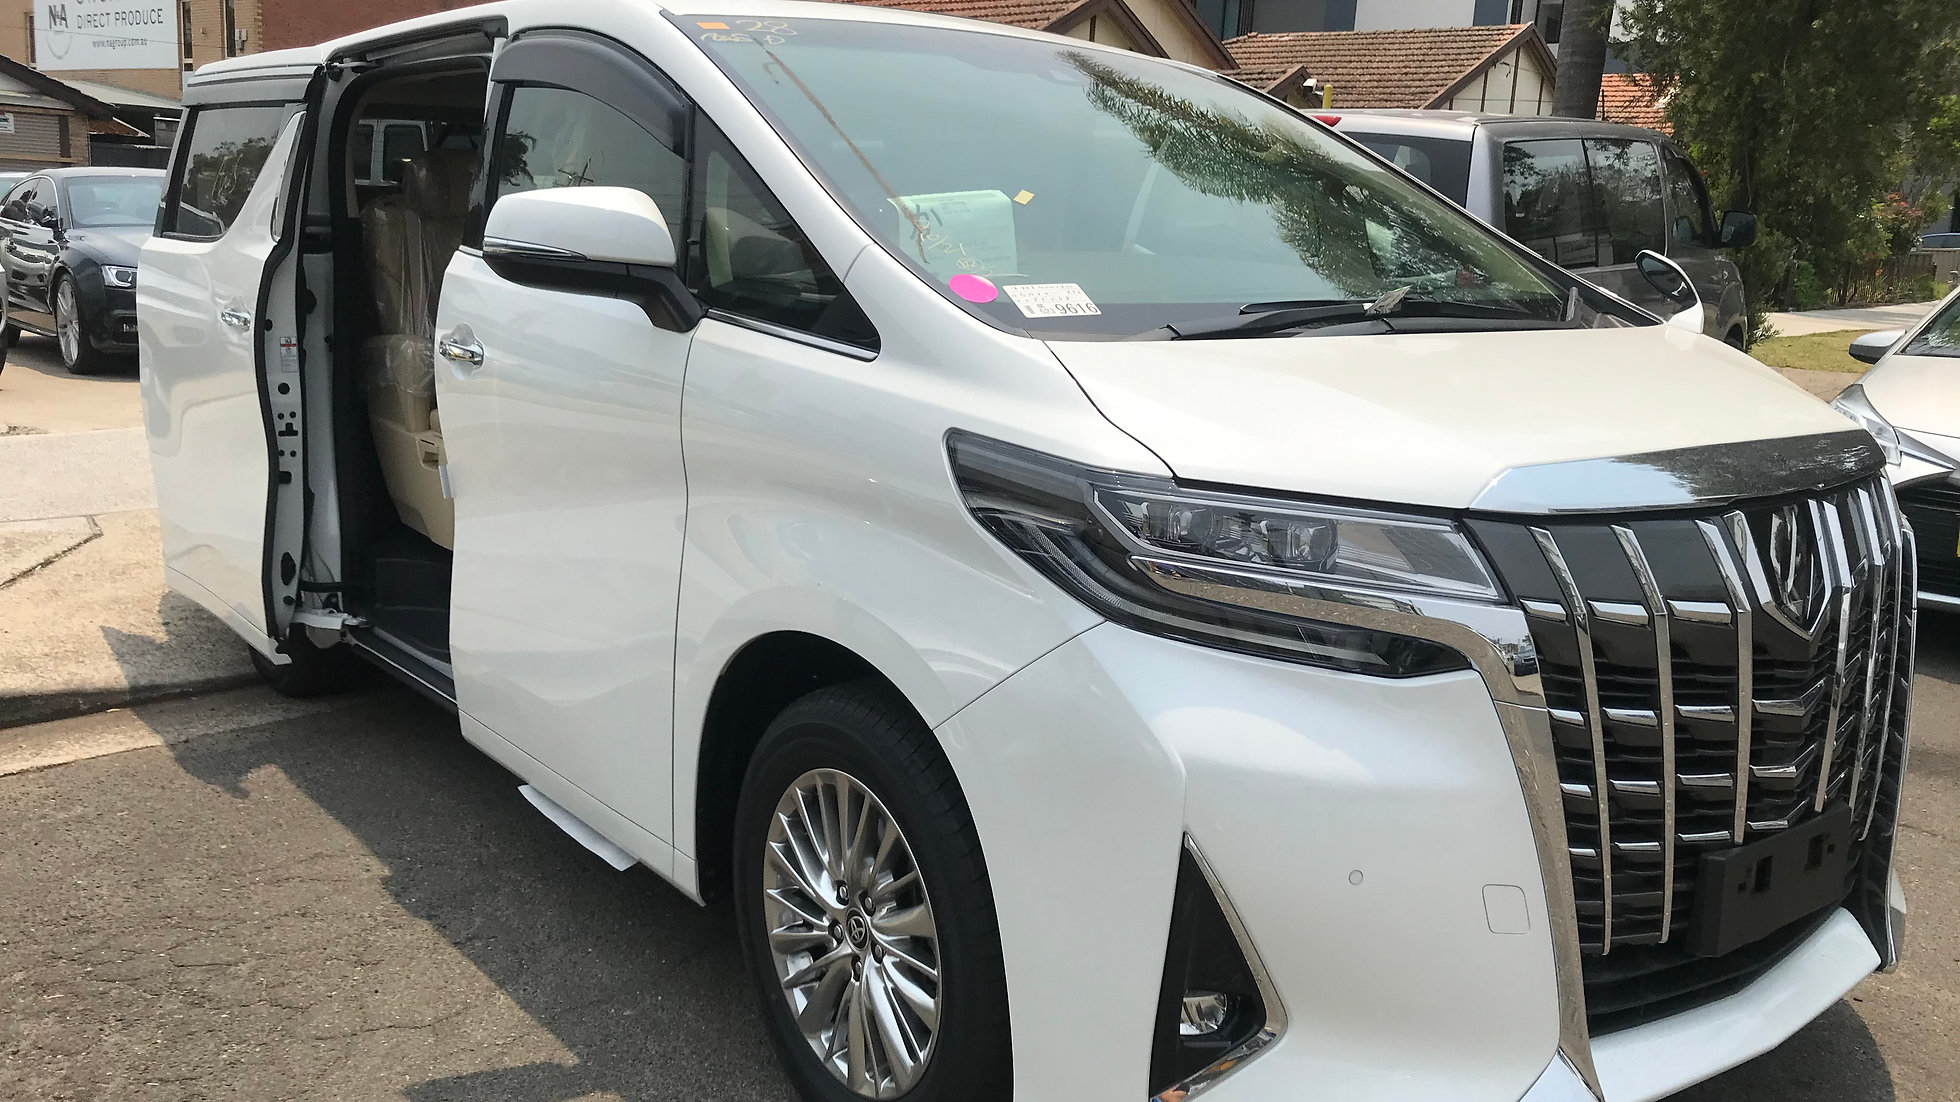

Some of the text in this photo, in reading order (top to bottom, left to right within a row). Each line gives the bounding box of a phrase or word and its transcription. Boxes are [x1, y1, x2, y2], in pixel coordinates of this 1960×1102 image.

[77, 8, 164, 29] DIRECT PRODUCE
[92, 38, 148, 50] www.nagroup.com.au
[1054, 303, 1098, 315] 9616
